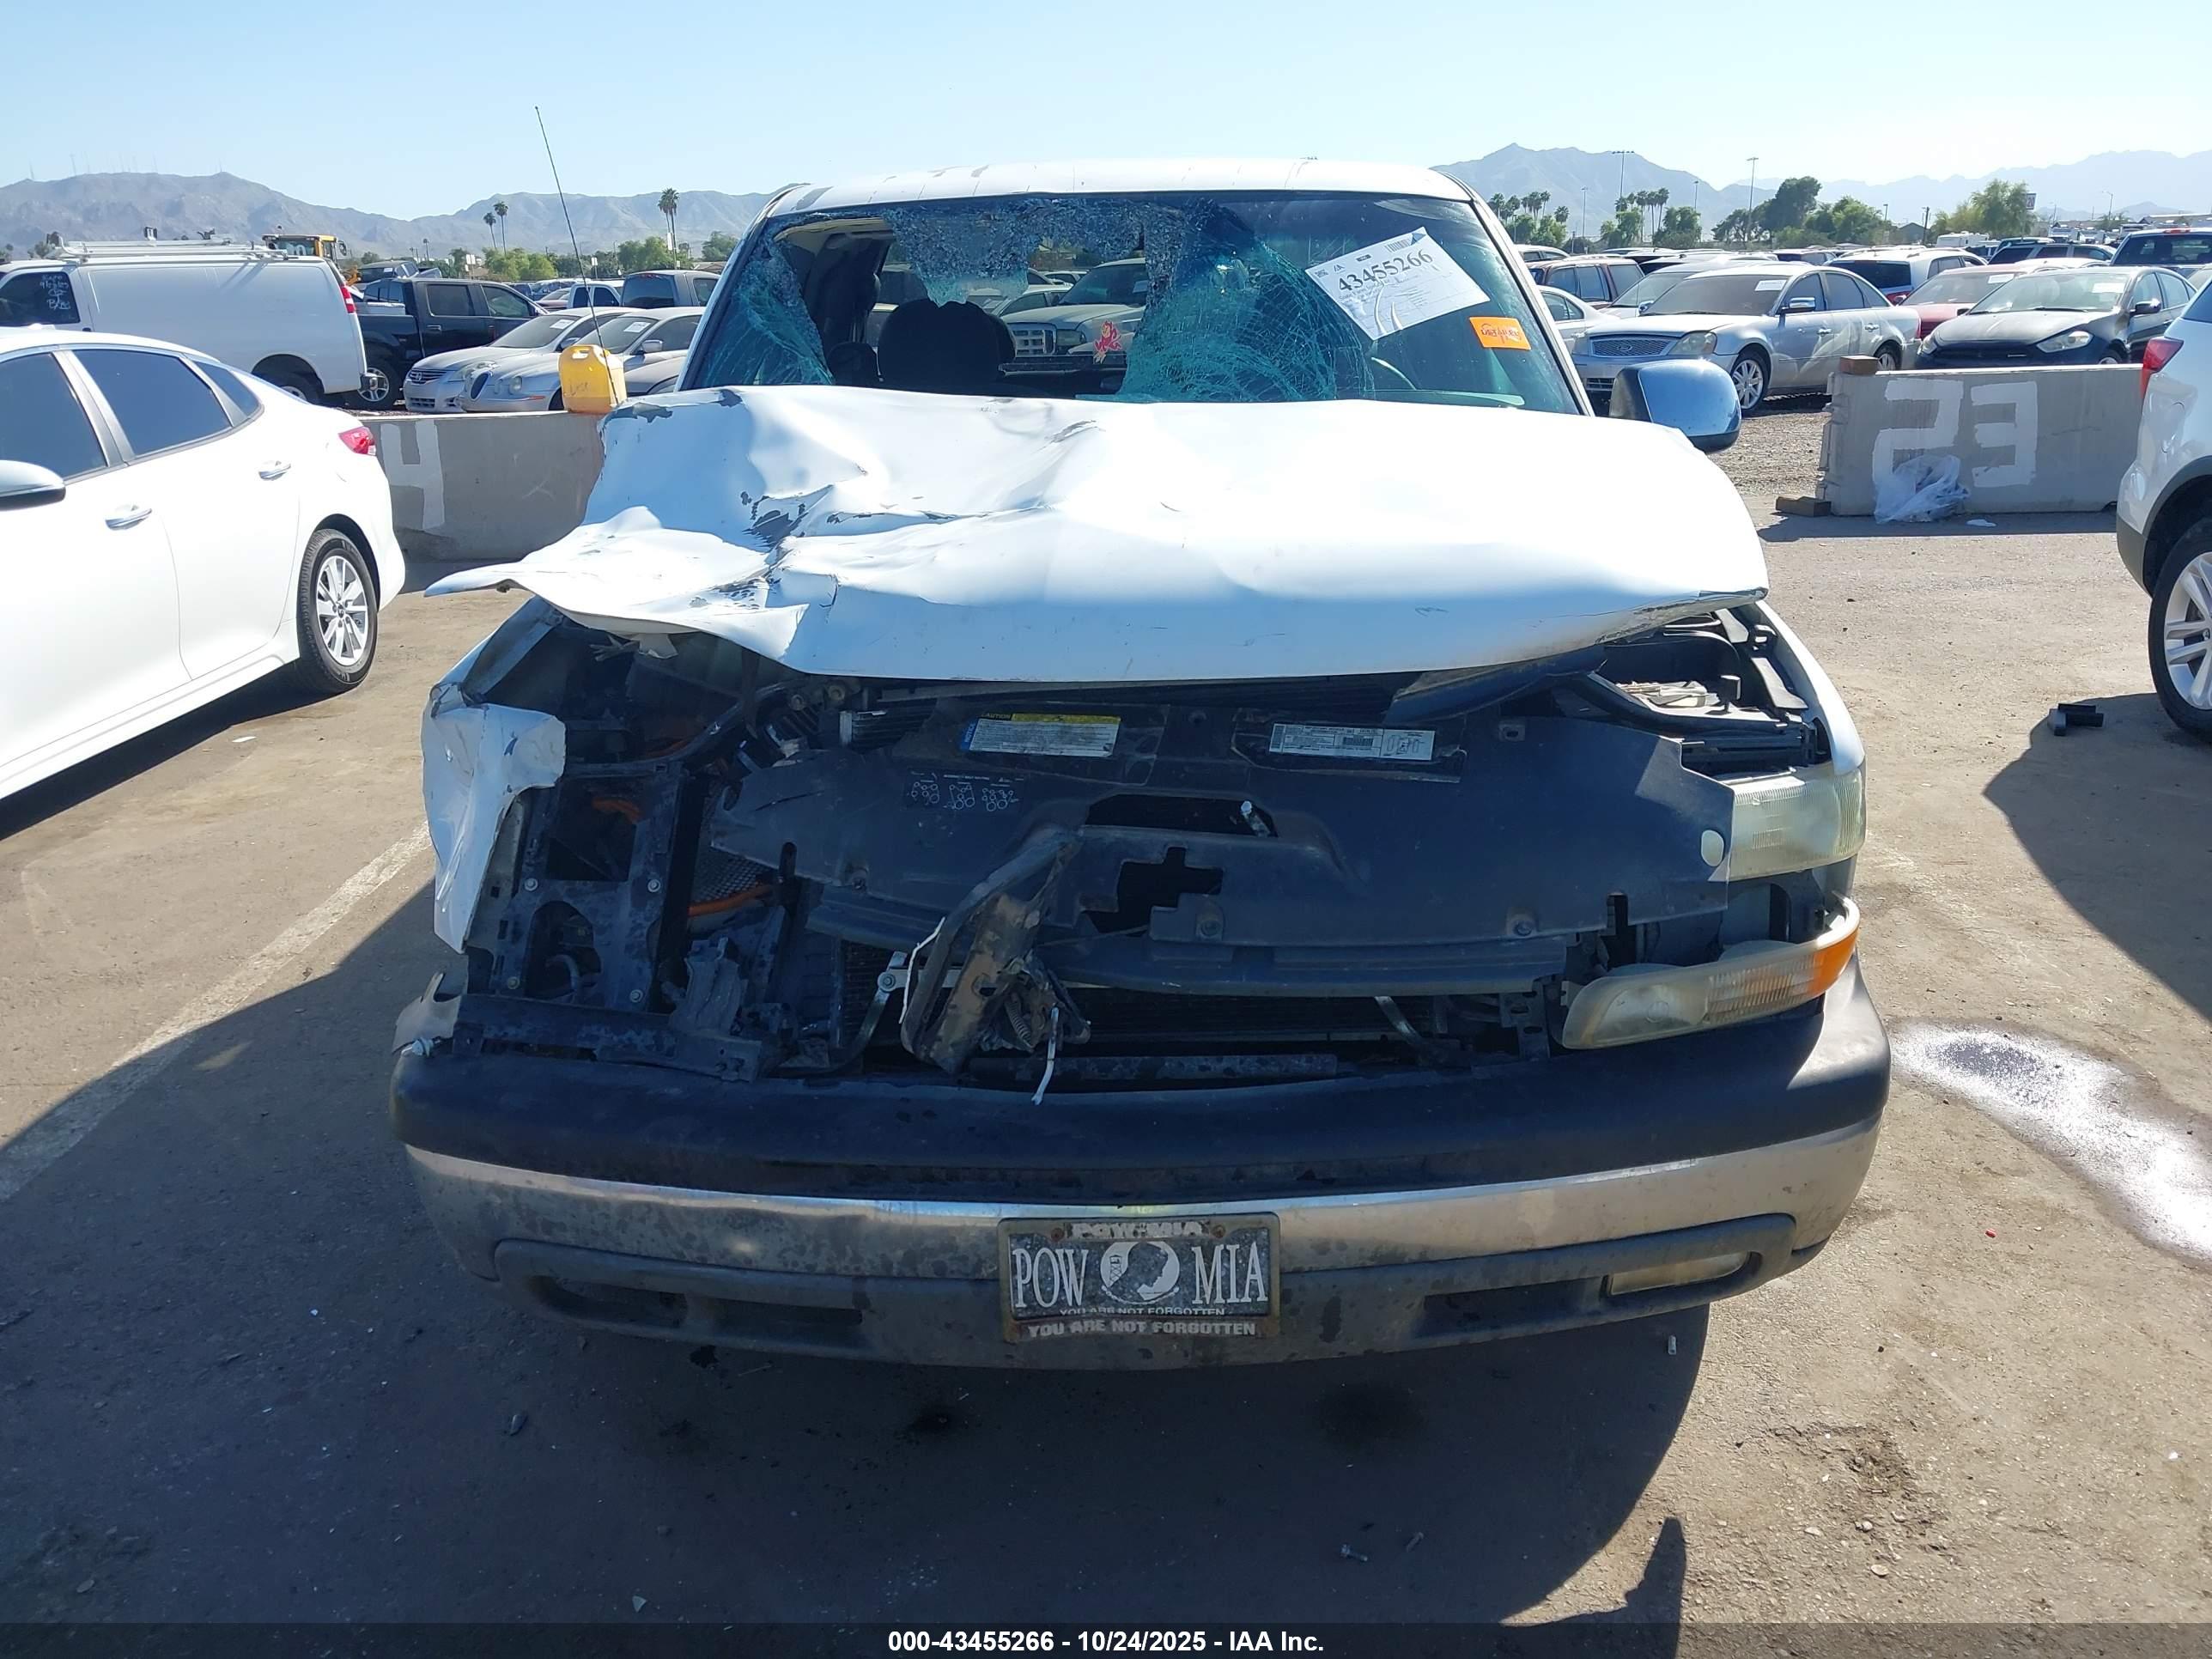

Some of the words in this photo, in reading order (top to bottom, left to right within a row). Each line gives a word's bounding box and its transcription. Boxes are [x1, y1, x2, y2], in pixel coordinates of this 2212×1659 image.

[1338, 248, 1433, 291] 43455266
[1872, 377, 2039, 488] 23
[1012, 1247, 1089, 1308] POW
[1191, 1241, 1268, 1305] MIA
[1028, 1322, 1065, 1338] YOU
[1067, 1319, 1106, 1334] ARE
[1112, 1319, 1146, 1334] NOT
[1153, 1321, 1256, 1335] FORGOTTEN
[1060, 1308, 1086, 1316] YOU
[1089, 1307, 1115, 1316] ARE
[1117, 1307, 1145, 1316] NOT
[1147, 1306, 1225, 1316] FORGOTTEN
